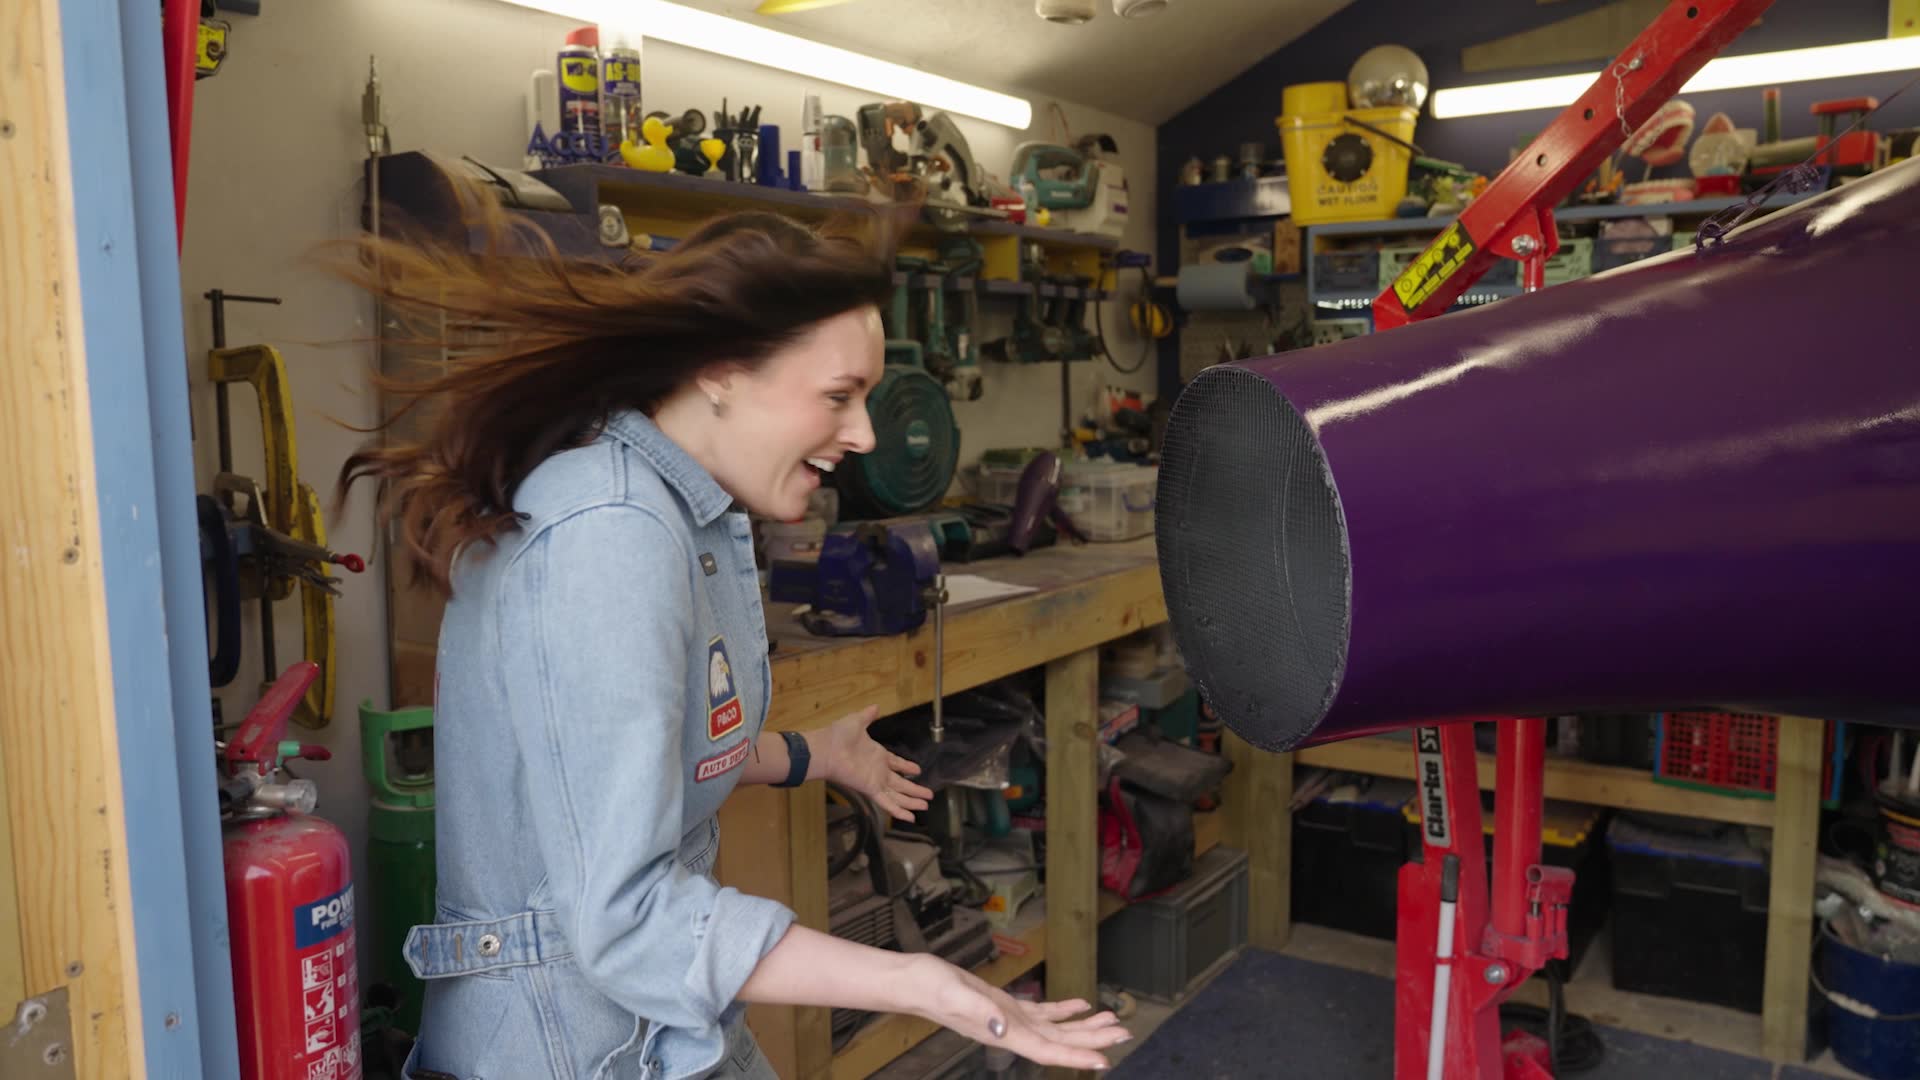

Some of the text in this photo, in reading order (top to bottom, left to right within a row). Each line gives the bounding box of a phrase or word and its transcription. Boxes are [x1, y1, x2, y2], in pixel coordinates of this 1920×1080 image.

[1317, 182, 1378, 194] CAUTION
[1318, 196, 1339, 206] WET
[702, 759, 728, 777] AUTO
[1423, 761, 1445, 839] Clarke
[311, 891, 353, 926] POW
